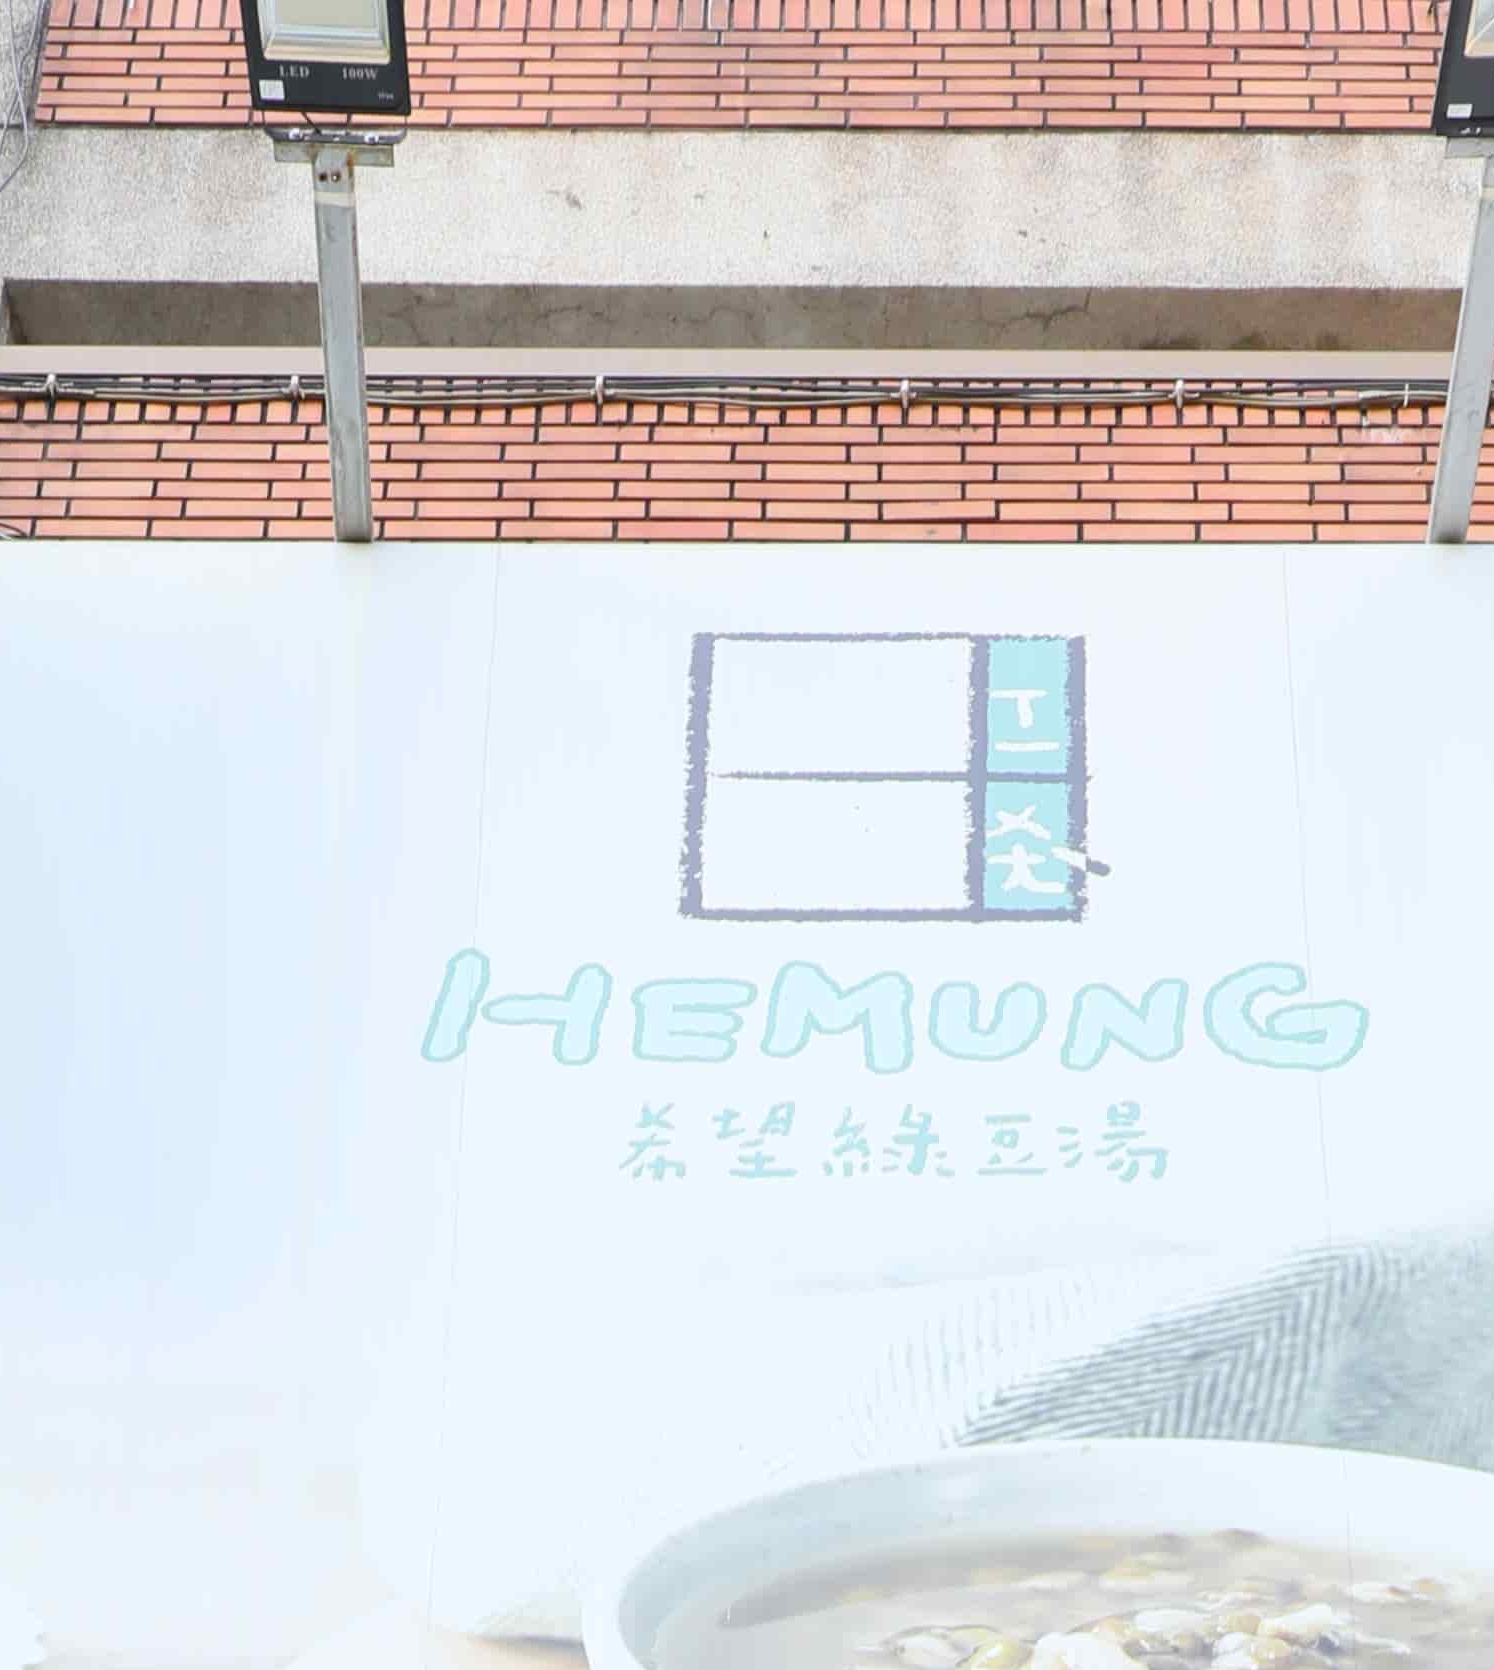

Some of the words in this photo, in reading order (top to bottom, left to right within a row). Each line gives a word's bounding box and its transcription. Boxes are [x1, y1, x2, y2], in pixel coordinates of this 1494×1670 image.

[278, 64, 310, 79] LED
[341, 66, 380, 81] 100W
[419, 946, 1370, 1075] HEMUNG
[617, 1100, 1171, 1184] 希望綠豆湯
